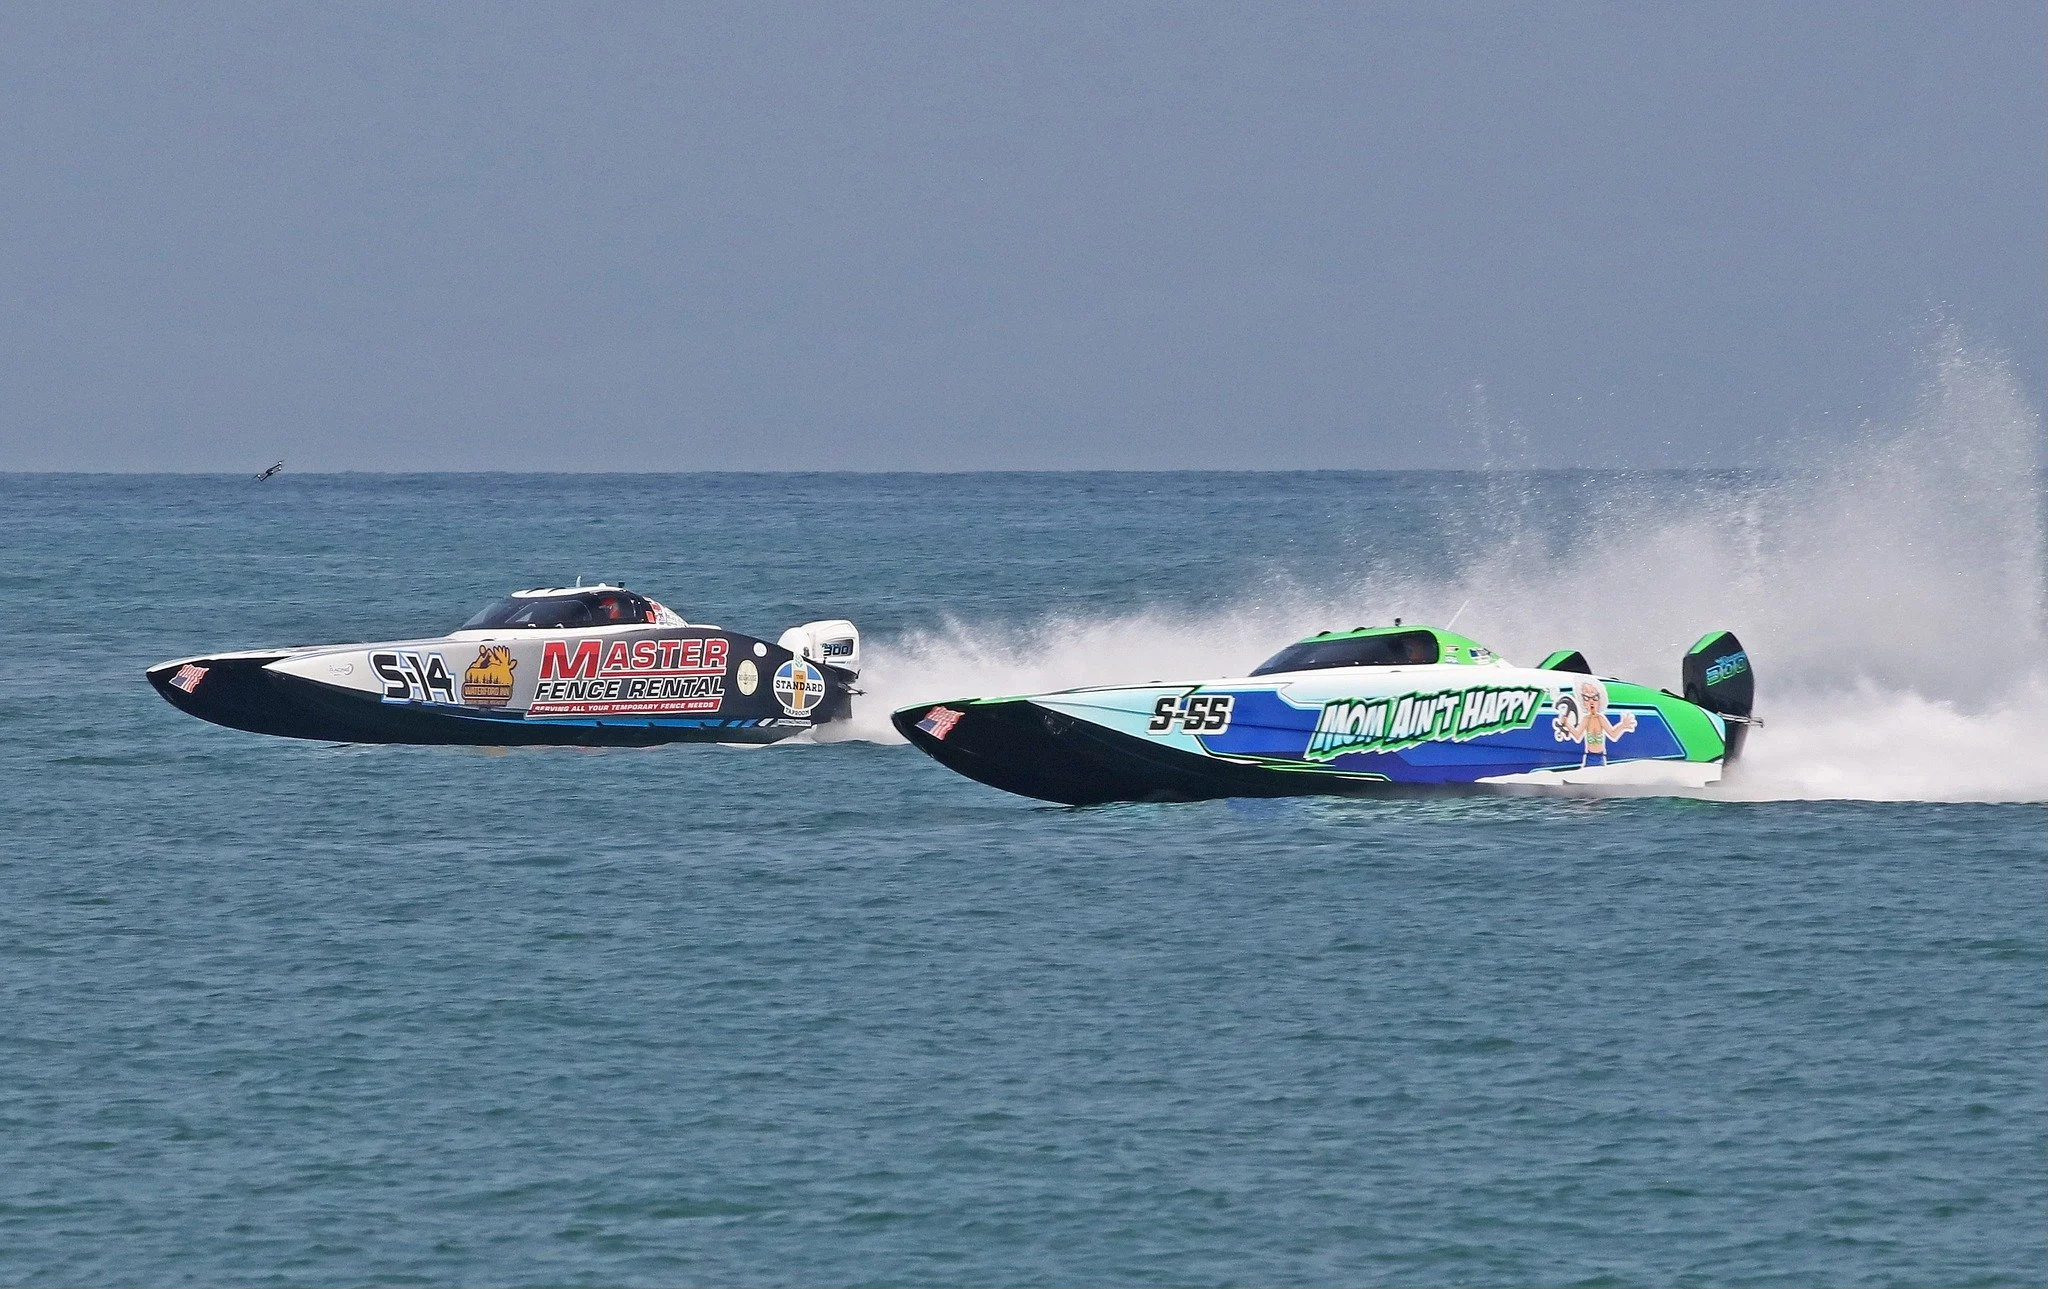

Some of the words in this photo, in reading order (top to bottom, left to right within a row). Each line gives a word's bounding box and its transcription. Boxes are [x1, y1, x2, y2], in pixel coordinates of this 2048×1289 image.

[539, 639, 729, 680] MASTER
[823, 643, 849, 656] 300
[372, 652, 456, 703] S-14
[534, 679, 622, 700] FENCE
[627, 677, 726, 699] RENTAL
[775, 680, 824, 693] STANDARD
[534, 705, 570, 713] SERVING
[571, 704, 586, 712] ALL
[588, 703, 609, 711] YOUR
[611, 702, 658, 711] TEMPORARY
[660, 701, 686, 709] FENCE
[687, 700, 715, 709] NEEDS
[1148, 696, 1231, 731] S-55
[1312, 702, 1388, 751] MOM
[1386, 694, 1460, 741] AIN'T
[1459, 689, 1539, 732] HAPPY
